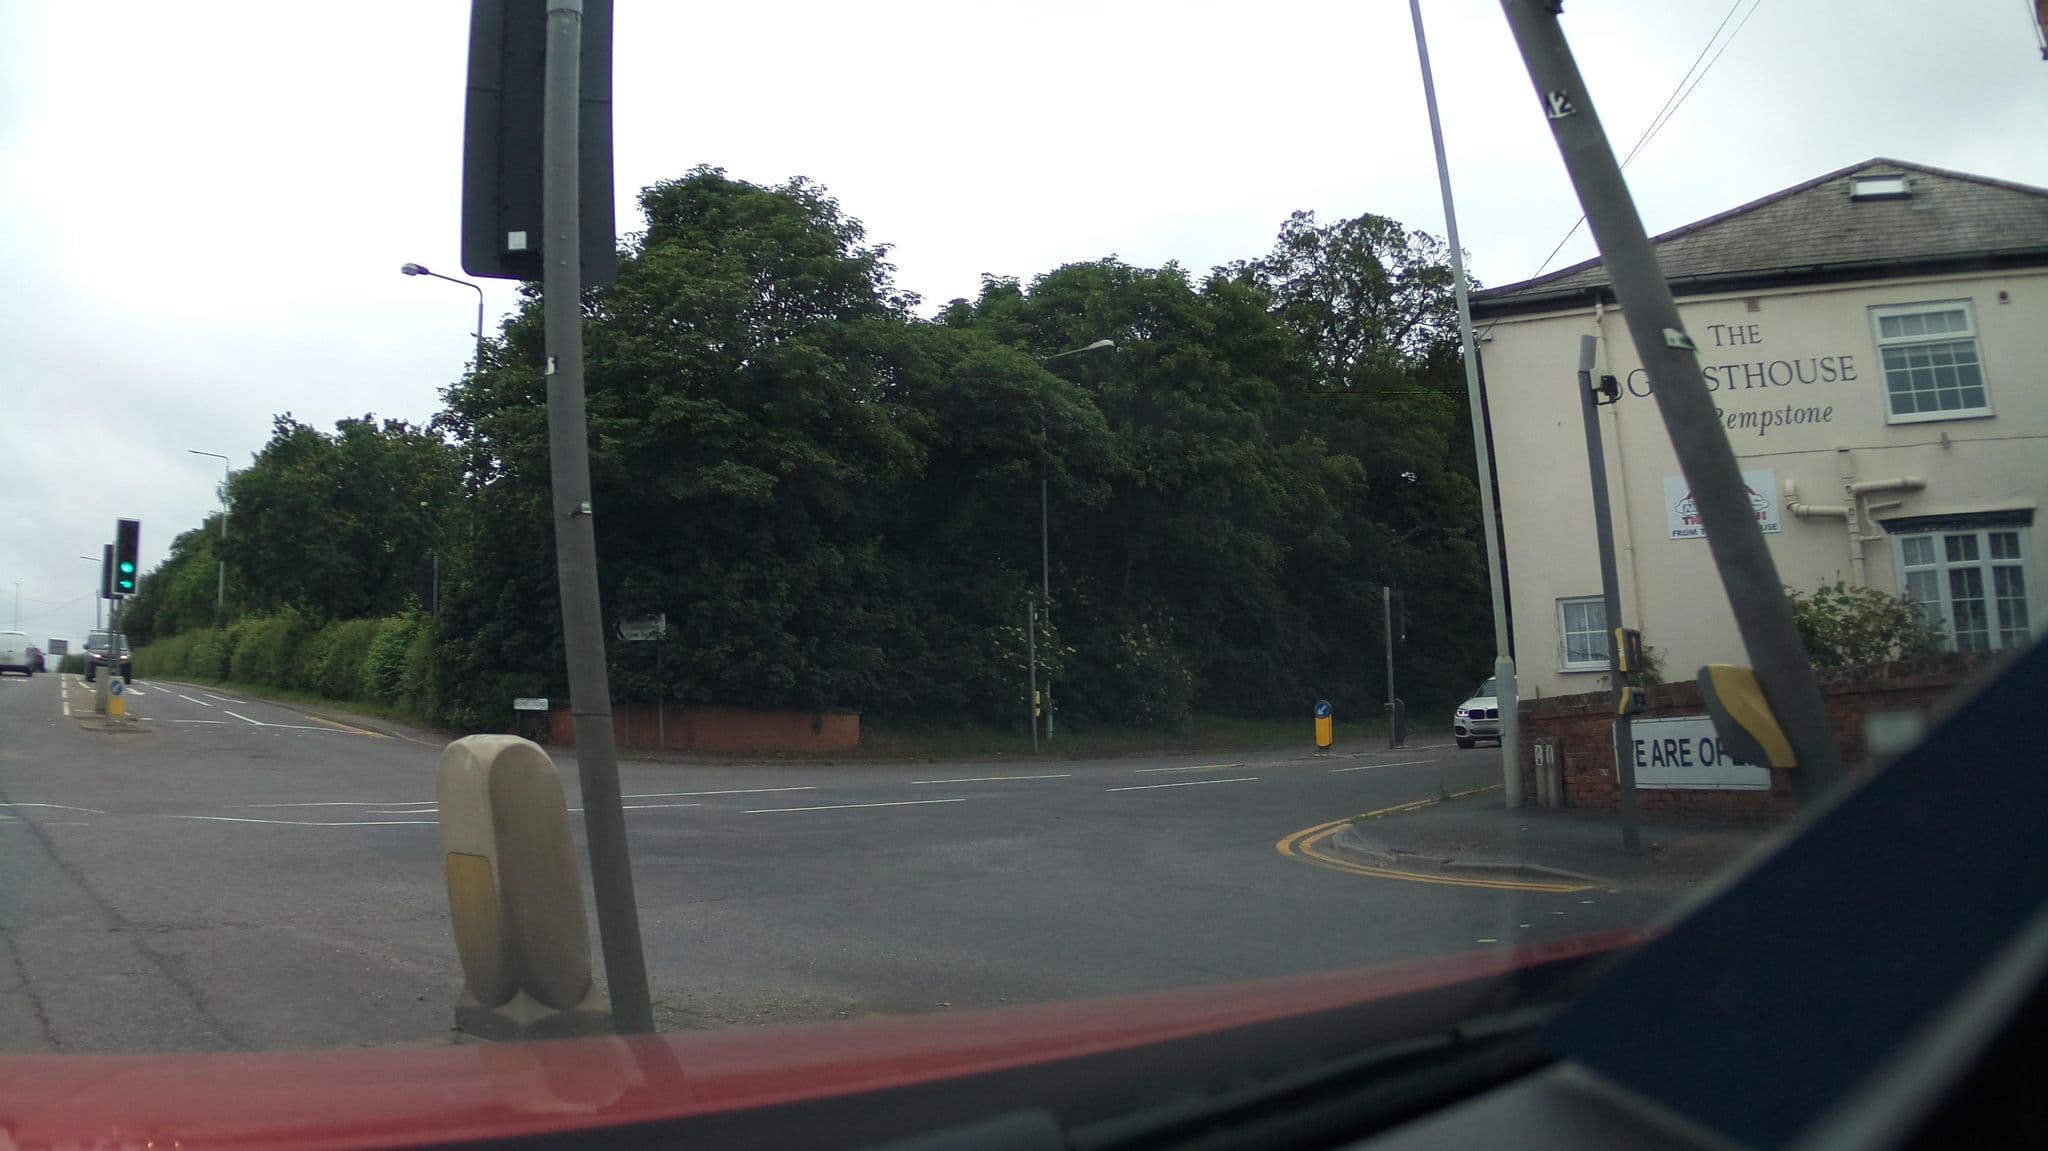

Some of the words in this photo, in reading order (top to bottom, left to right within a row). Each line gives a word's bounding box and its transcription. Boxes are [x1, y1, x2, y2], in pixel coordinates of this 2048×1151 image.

[1707, 324, 1762, 347] THE
[1627, 355, 1858, 398] GSTHOUSE
[1672, 528, 1698, 537] FROM
[1652, 738, 1693, 767] ARE
